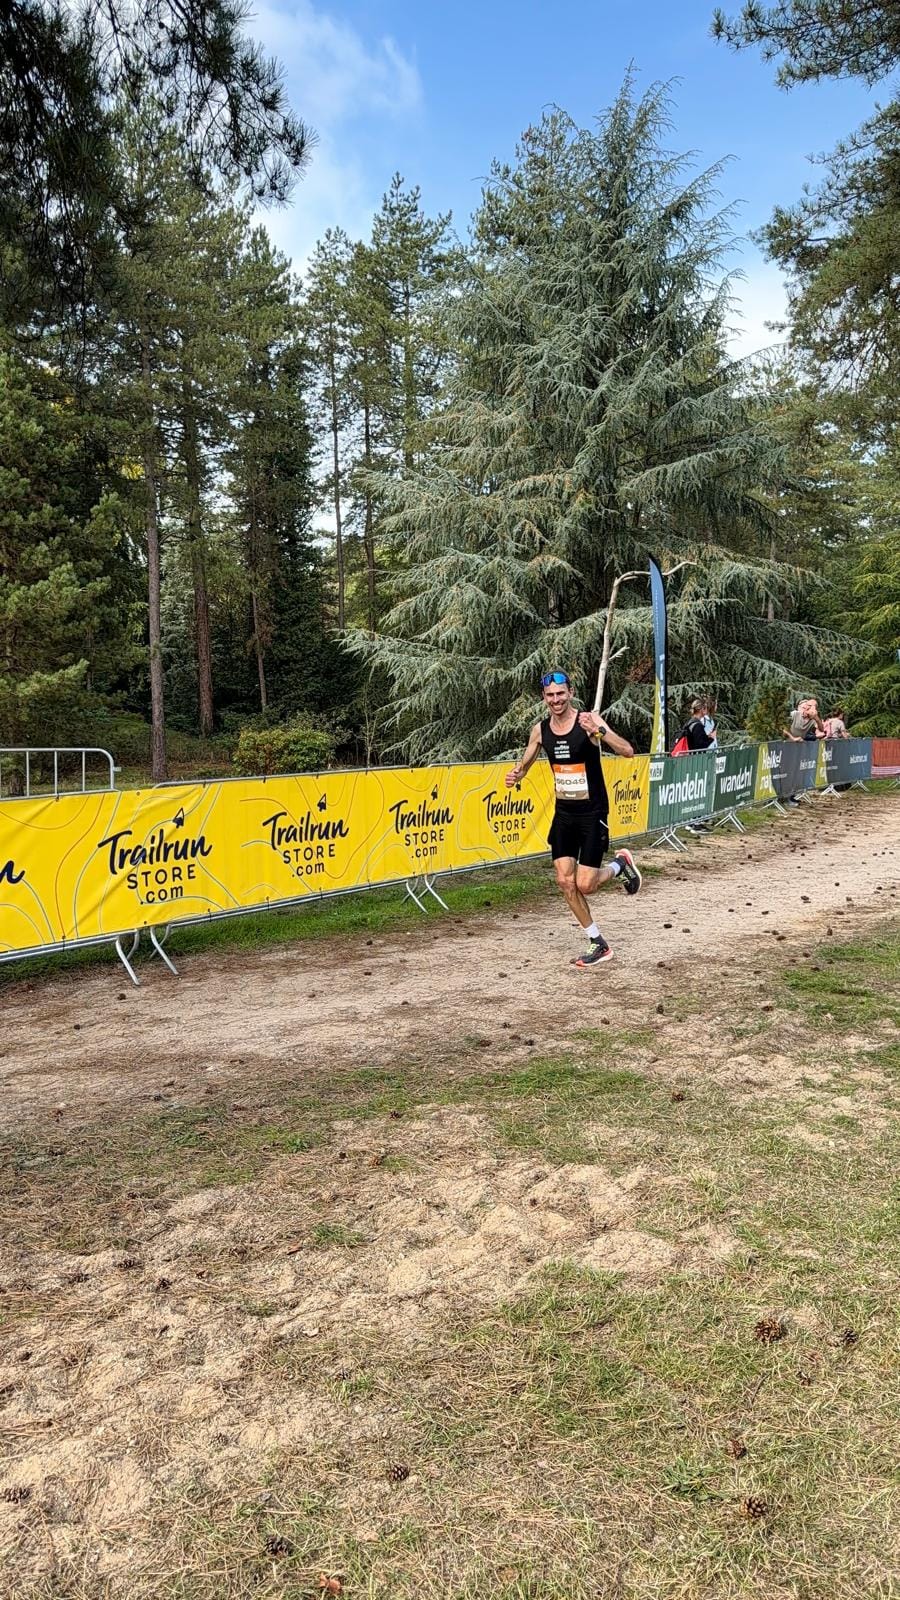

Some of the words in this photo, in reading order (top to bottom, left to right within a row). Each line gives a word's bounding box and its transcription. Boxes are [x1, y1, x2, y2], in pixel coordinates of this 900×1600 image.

[614, 779, 642, 805] Trailrun
[389, 800, 454, 834] Trailrun
[483, 791, 535, 822] Trailrun
[618, 803, 637, 815] STORE
[262, 811, 350, 851] Trailrun
[493, 817, 527, 833] STORE
[404, 828, 445, 847] STORE
[499, 832, 520, 844] .com
[97, 829, 213, 875] Trailrun
[283, 843, 336, 865] STORE
[411, 845, 438, 859] .com
[127, 863, 196, 890] STORE
[292, 862, 326, 878] .com
[140, 885, 184, 905] .com
